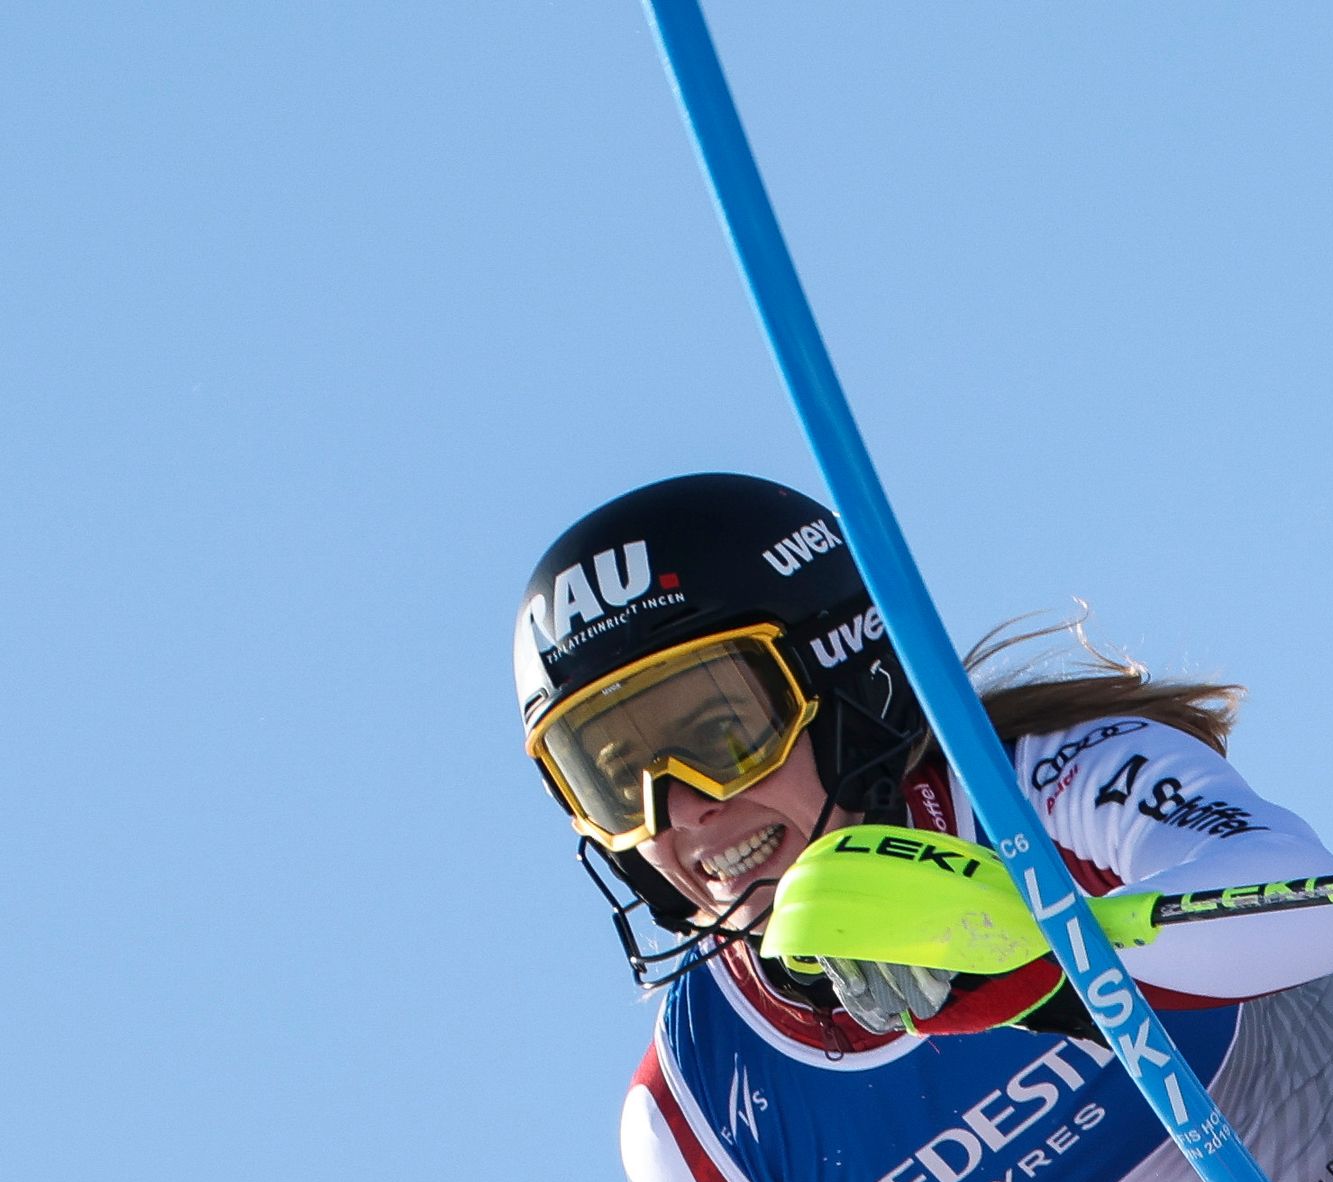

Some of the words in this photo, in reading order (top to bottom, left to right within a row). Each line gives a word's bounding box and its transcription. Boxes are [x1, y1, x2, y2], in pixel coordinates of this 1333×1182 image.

[762, 519, 843, 577] uvex
[809, 606, 885, 669] uve
[834, 835, 981, 878] LEKI
[1000, 834, 1030, 860] C6
[1024, 867, 1188, 1126] LISKI
